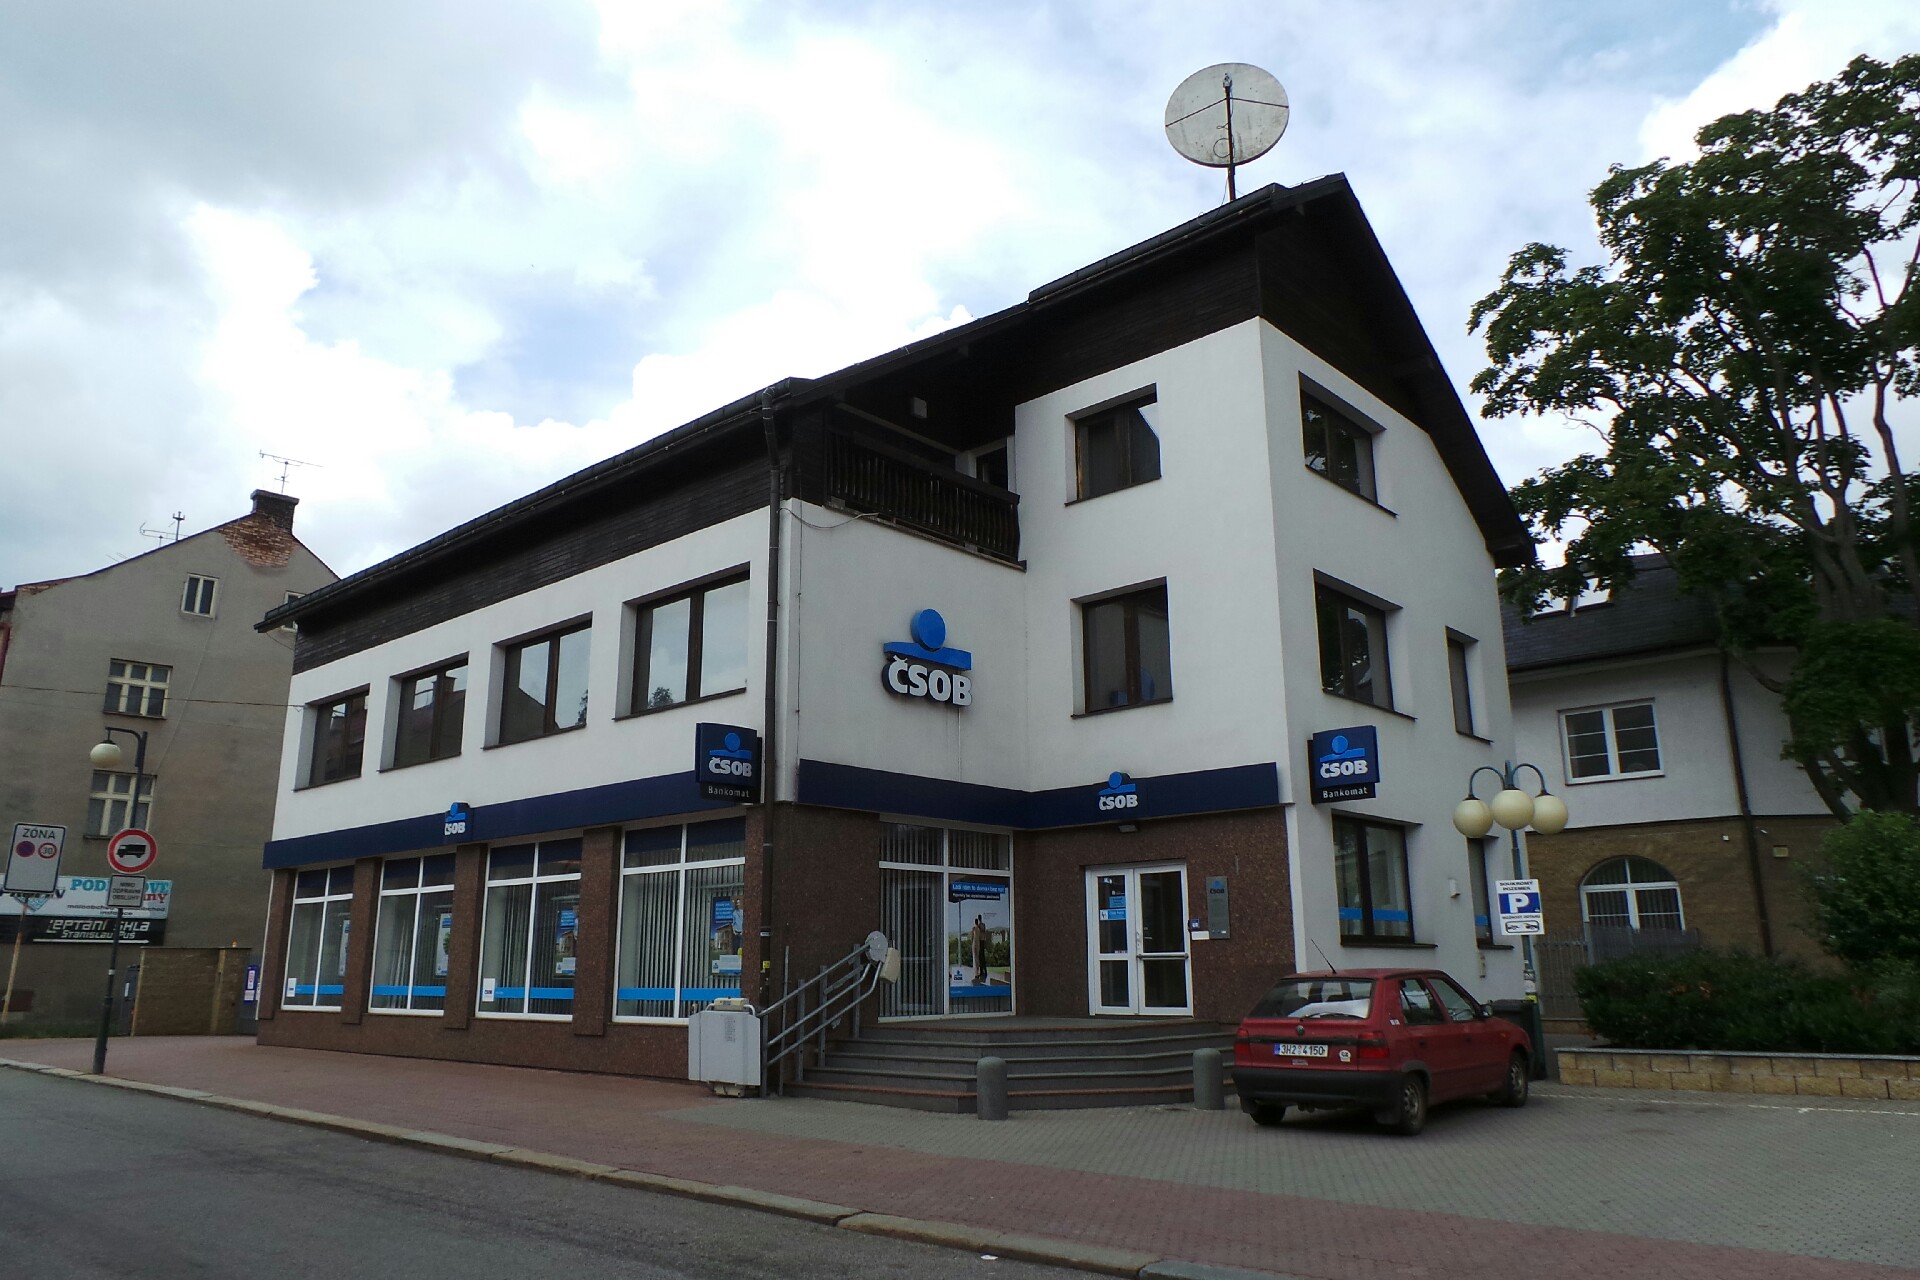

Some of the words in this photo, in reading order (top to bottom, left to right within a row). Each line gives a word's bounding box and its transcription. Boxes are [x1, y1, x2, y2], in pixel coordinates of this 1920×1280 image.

[888, 654, 972, 706] ČSOB
[709, 757, 752, 777] ČSOB
[1320, 760, 1368, 778] ČSOB
[708, 786, 750, 798] Bankomat
[1322, 787, 1368, 798] Bankomat
[1099, 795, 1138, 810] ČSOB
[42, 847, 53, 855] 30
[1508, 893, 1530, 914] P
[1281, 1044, 1297, 1055] 3H2
[1302, 1045, 1326, 1056] 4150
